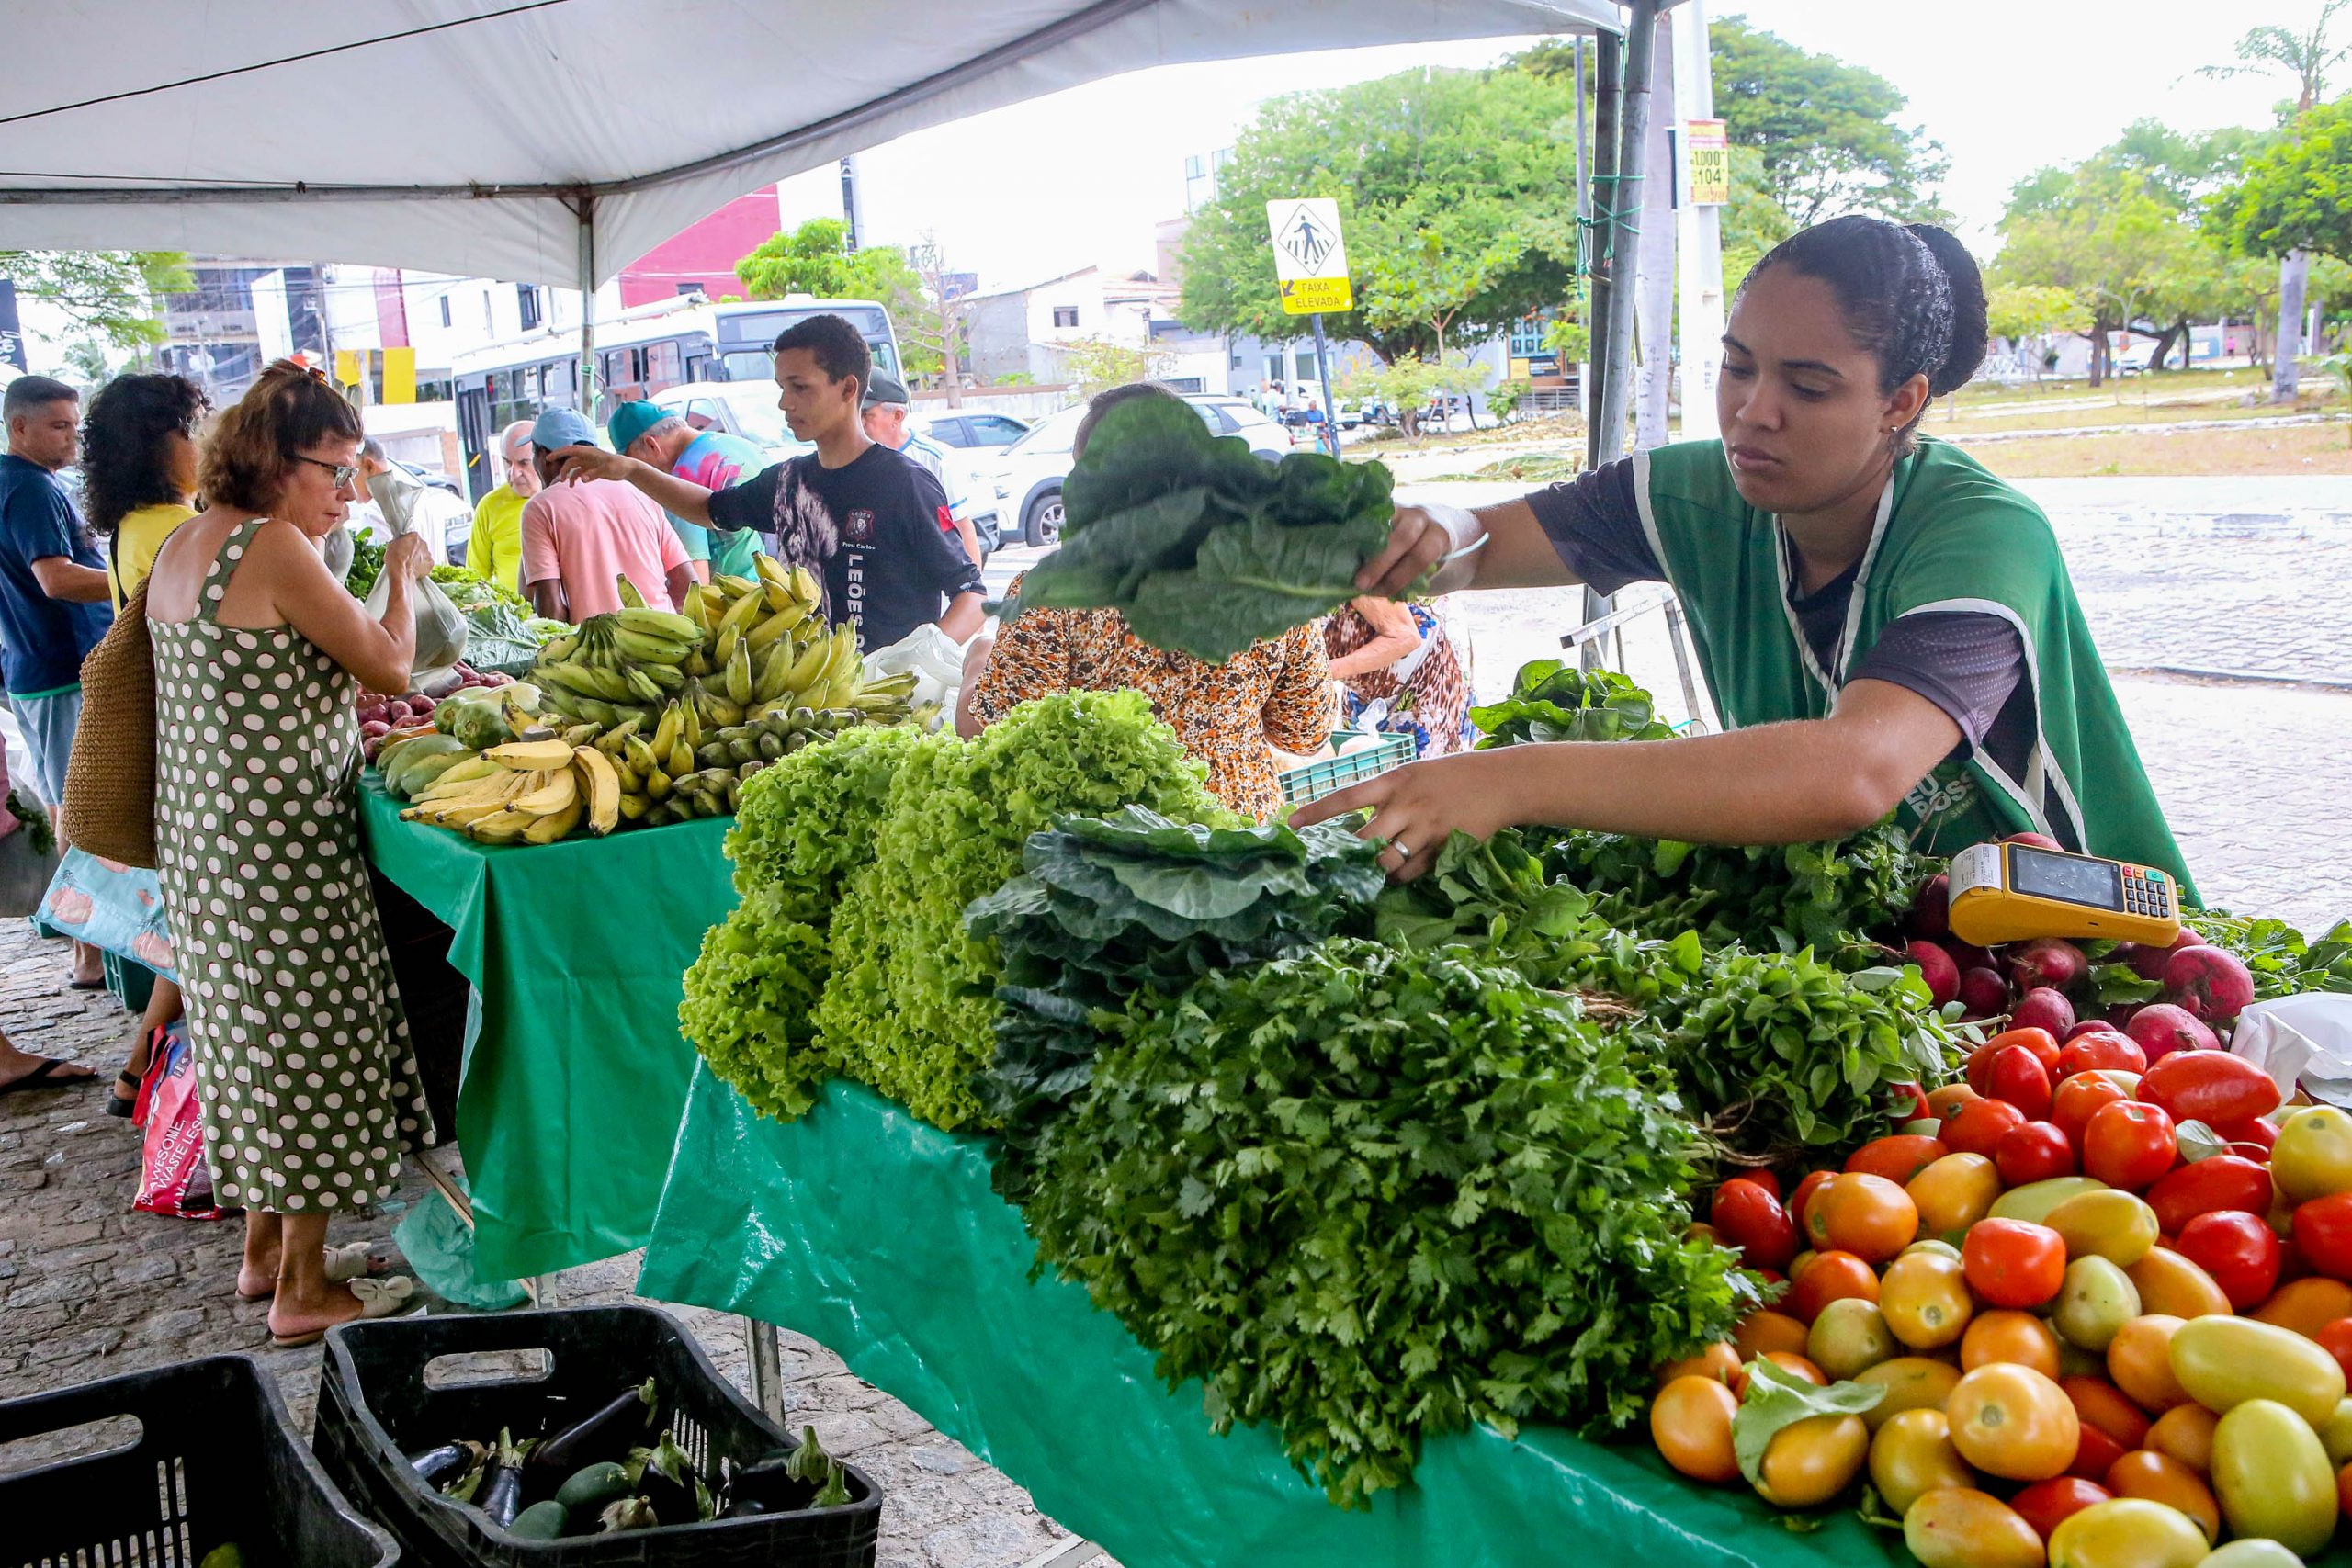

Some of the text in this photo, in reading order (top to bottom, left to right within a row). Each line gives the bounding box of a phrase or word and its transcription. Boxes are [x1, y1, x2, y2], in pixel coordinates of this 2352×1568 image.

[1698, 168, 1722, 185] 104
[1295, 296, 1340, 309] ELEVADA
[1302, 282, 1330, 293] FAIXA
[847, 553, 866, 626] LEÕES
[149, 1119, 187, 1191] AWESOME,
[157, 1144, 188, 1189] WASTE
